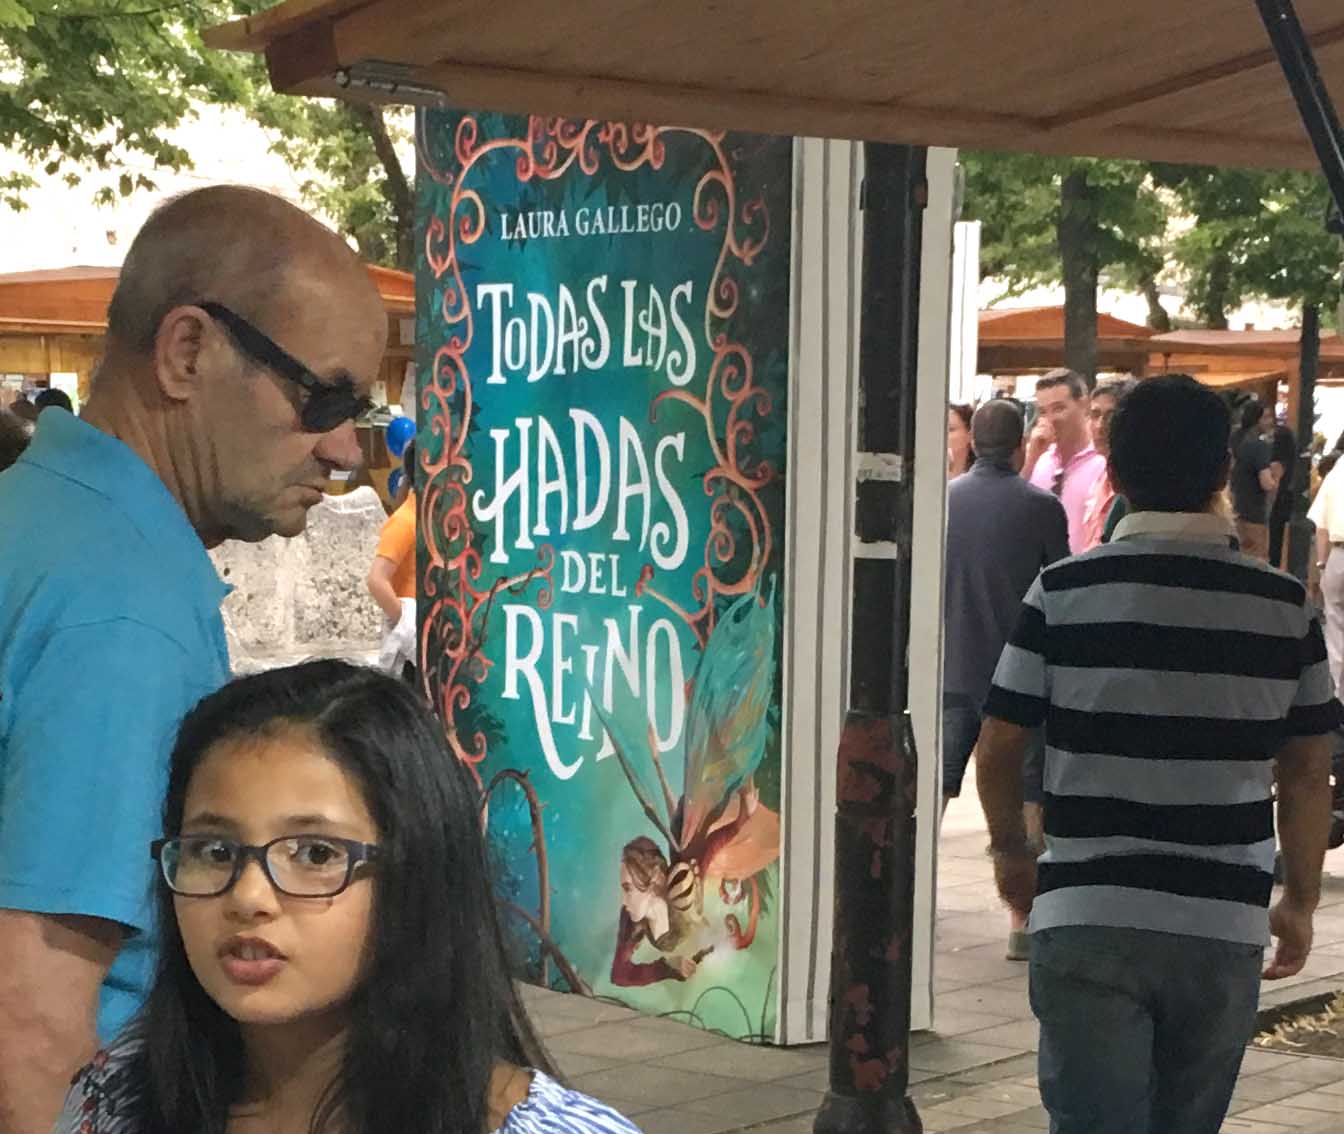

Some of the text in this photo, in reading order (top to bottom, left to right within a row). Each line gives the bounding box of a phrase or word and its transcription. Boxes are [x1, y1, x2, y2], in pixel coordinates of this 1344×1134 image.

[500, 202, 682, 241] LAURA GALLEGO
[476, 274, 697, 387] TODAS LAS
[473, 408, 691, 571] HADAS
[560, 549, 627, 598] DEL
[500, 603, 687, 781] REINO
